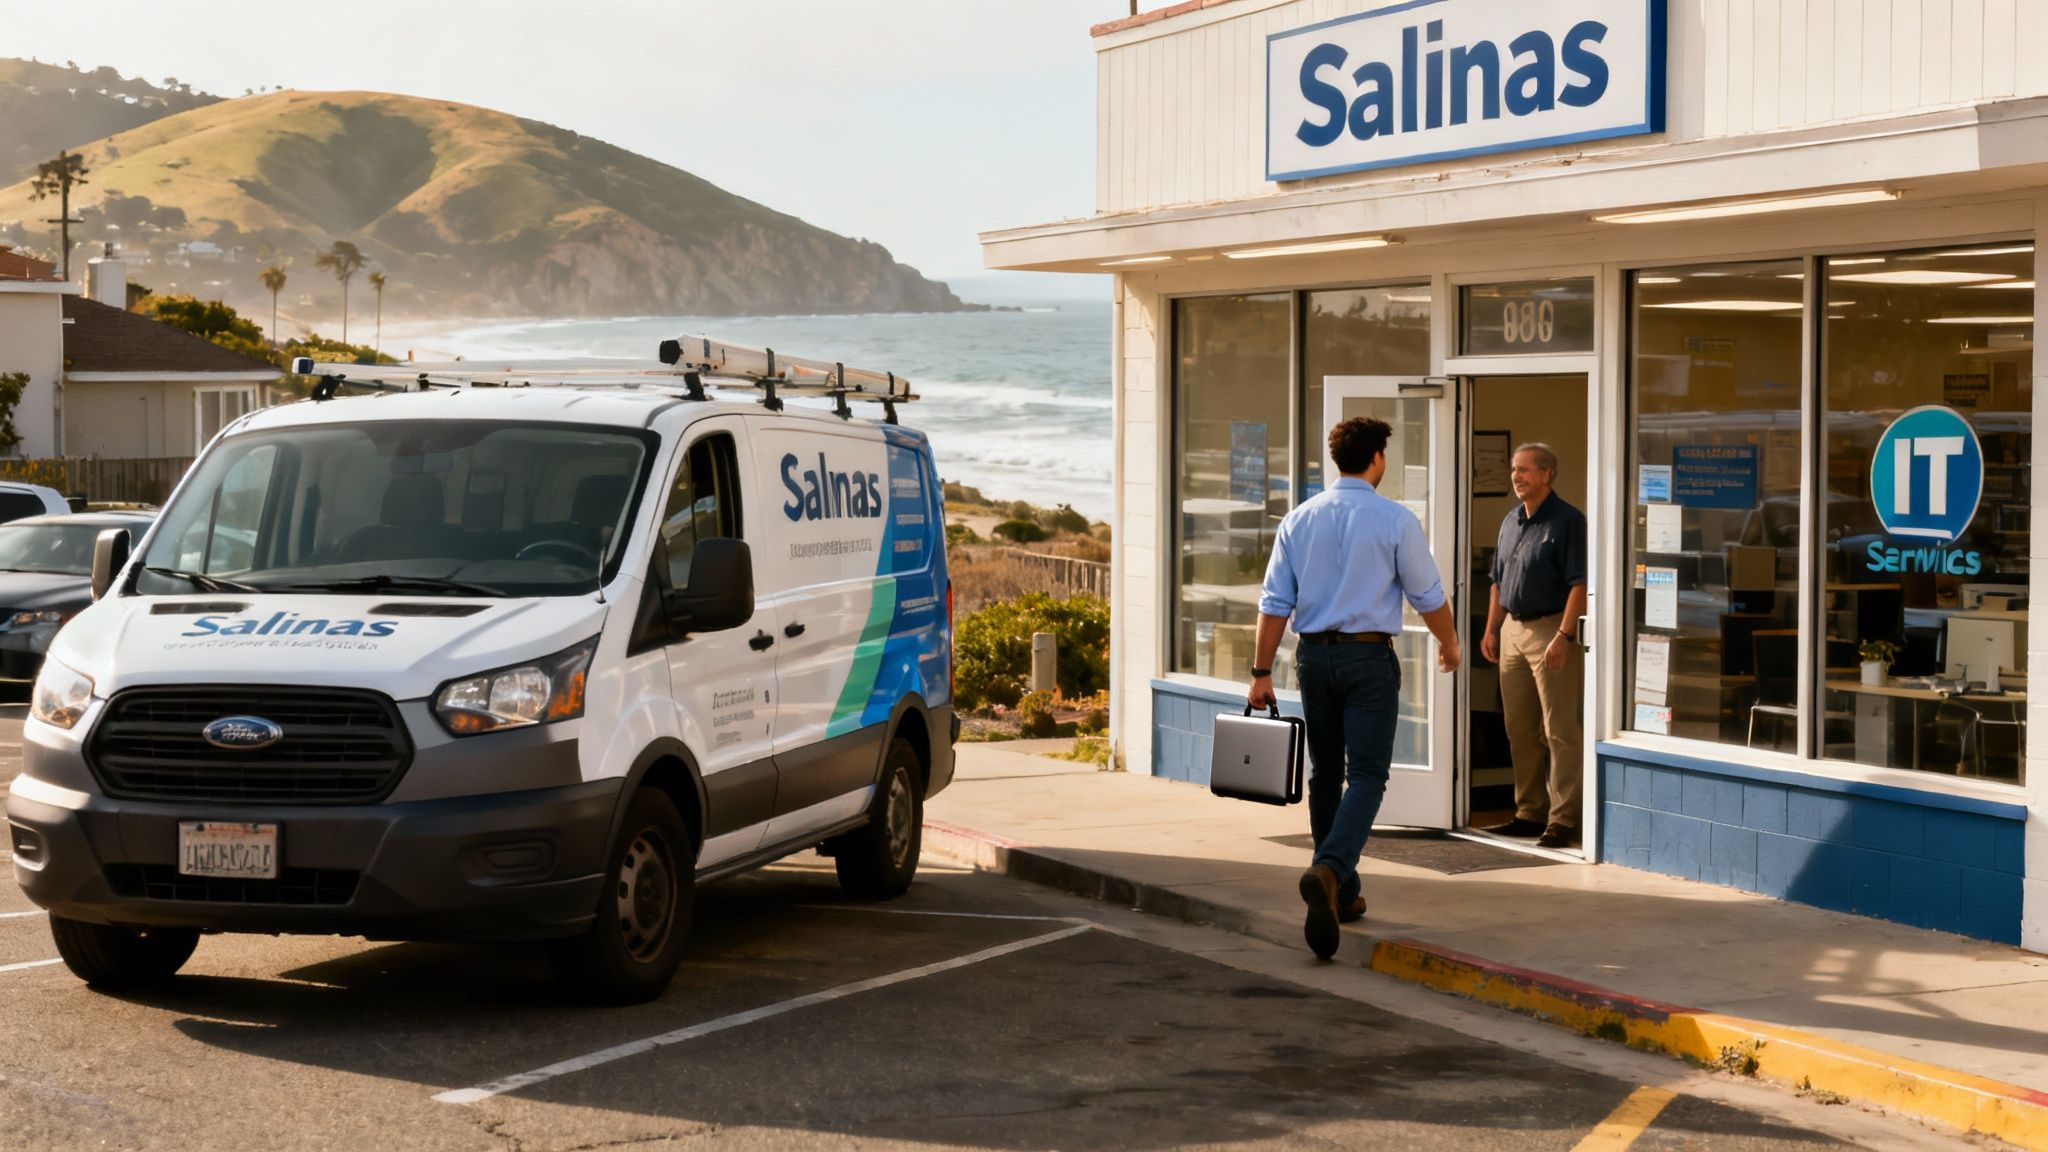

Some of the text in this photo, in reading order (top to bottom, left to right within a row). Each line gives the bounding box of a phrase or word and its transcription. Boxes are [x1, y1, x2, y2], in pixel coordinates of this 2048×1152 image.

[1296, 18, 1609, 148] Salinas
[1893, 436, 1965, 516] IT
[181, 611, 400, 637] Salinas
